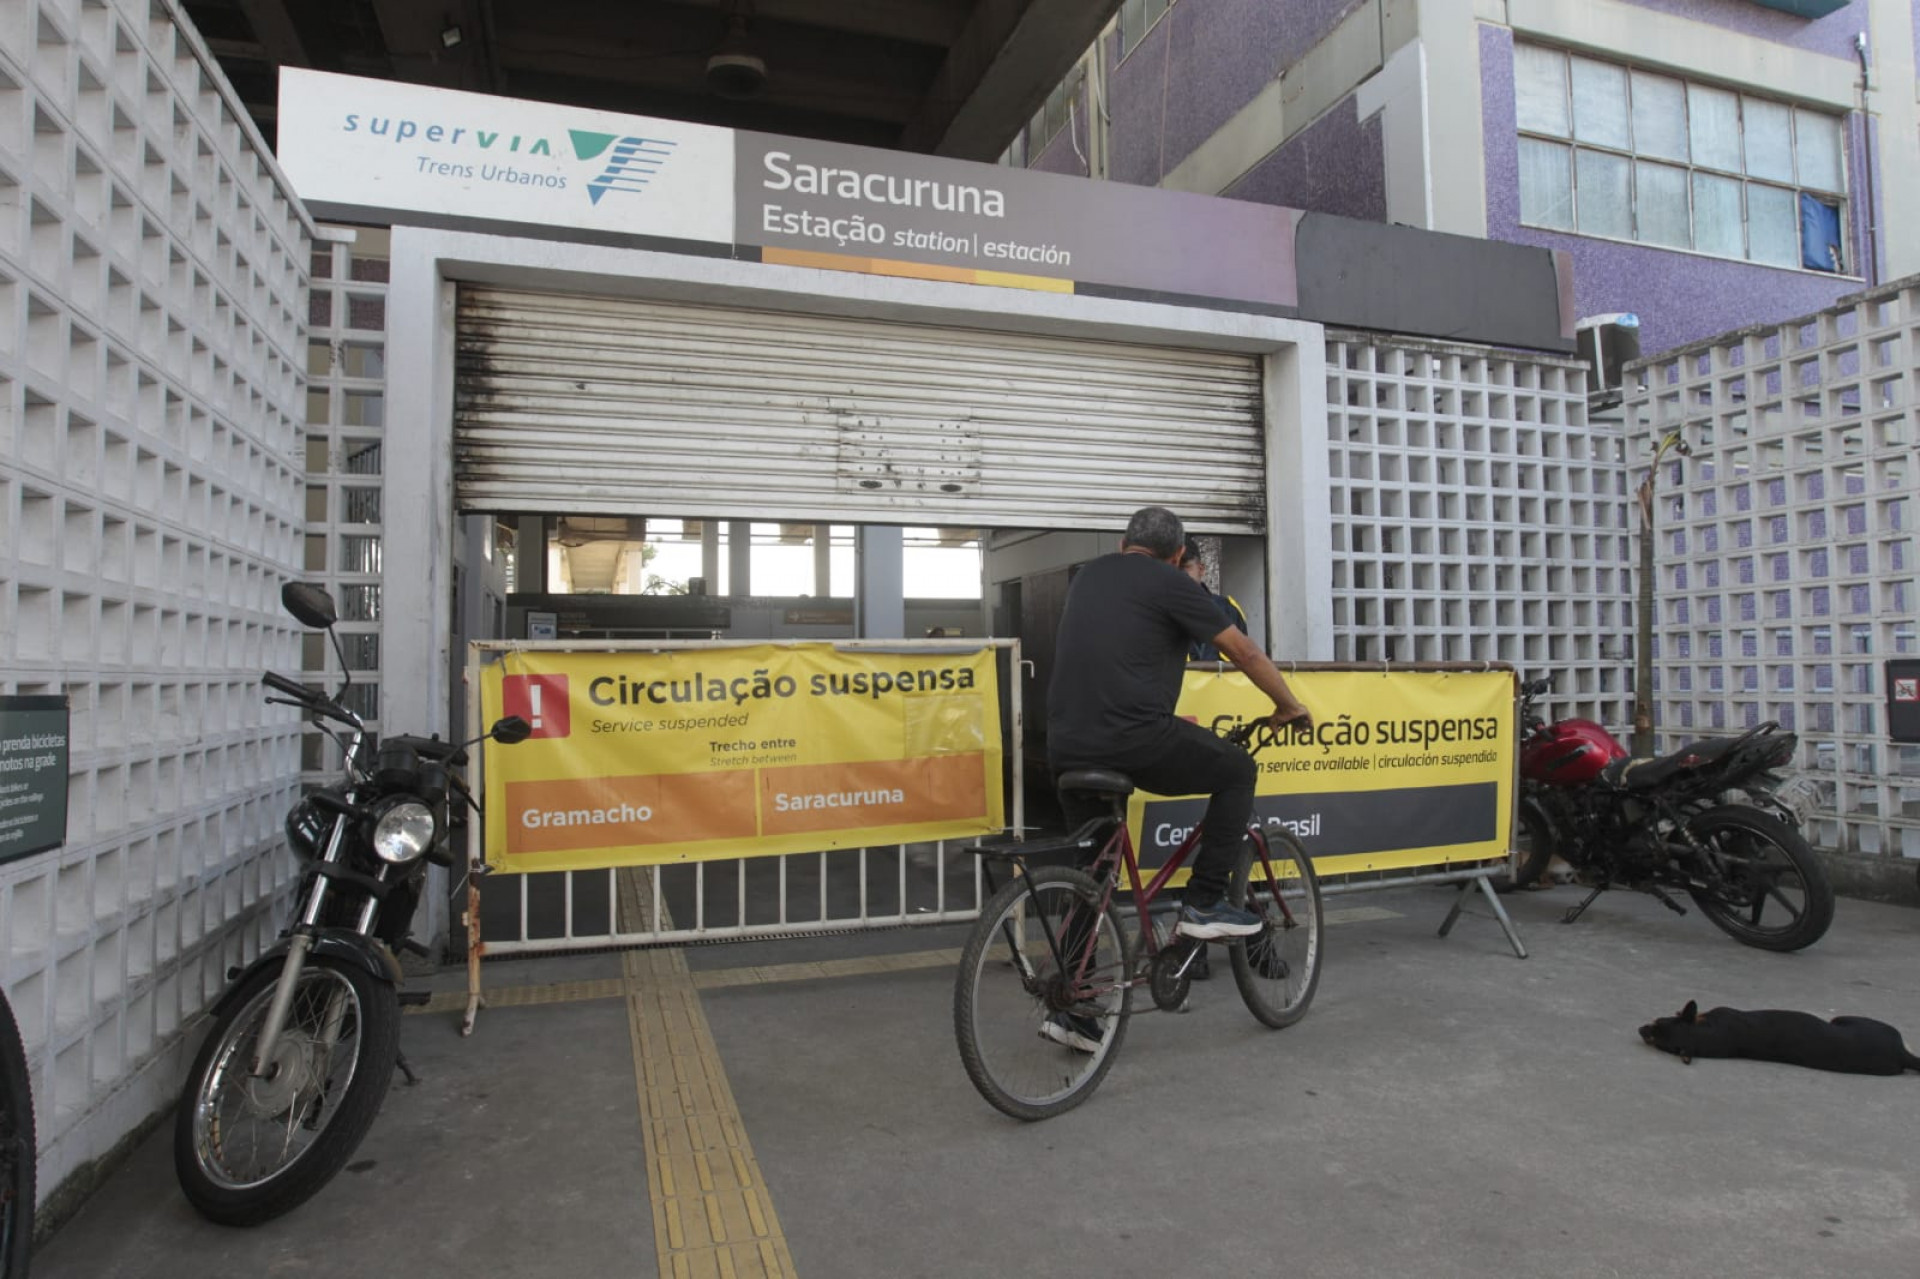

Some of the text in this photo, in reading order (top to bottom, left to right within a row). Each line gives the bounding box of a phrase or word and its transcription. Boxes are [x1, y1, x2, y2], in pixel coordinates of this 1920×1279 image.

[417, 156, 567, 189] Trens Urbanos
[763, 151, 1005, 217] Saracuruna
[763, 204, 1071, 265] Estação station estación
[589, 667, 975, 706] Circulação suspensa
[591, 712, 749, 734] Service suspended
[1376, 716, 1498, 750] suspensa
[2, 734, 31, 756] prenda
[710, 737, 796, 753] Trecho entre
[24, 757, 34, 769] na
[710, 752, 797, 767] Stretch between
[1267, 758, 1311, 773] service
[1313, 756, 1370, 771] available
[1378, 753, 1439, 769] circulación
[1441, 749, 1498, 767] suspendida
[775, 789, 904, 812] Saracuruna
[522, 803, 652, 829] Gramacho
